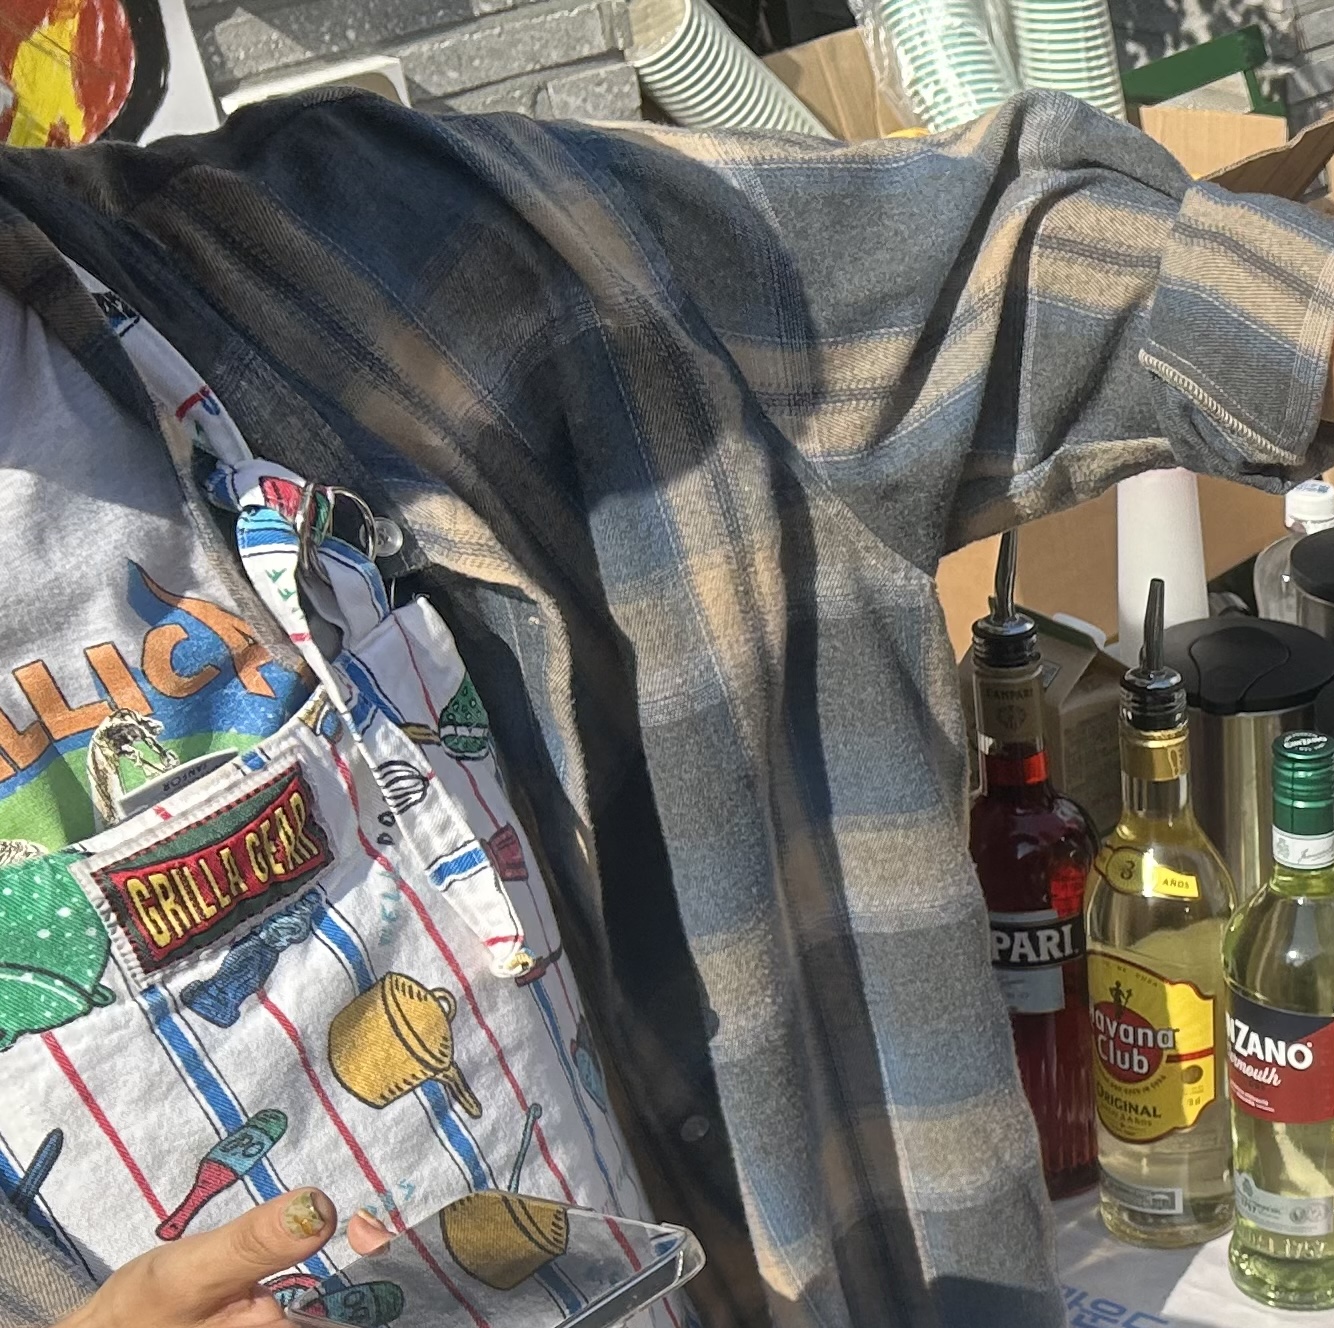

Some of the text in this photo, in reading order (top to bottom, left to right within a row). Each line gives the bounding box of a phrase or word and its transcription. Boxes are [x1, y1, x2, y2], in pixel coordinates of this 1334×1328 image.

[125, 791, 318, 948] GRILLA GEAR
[1120, 860, 1137, 881] 3
[1162, 875, 1191, 890] AÑOS
[1097, 1034, 1151, 1075] Club
